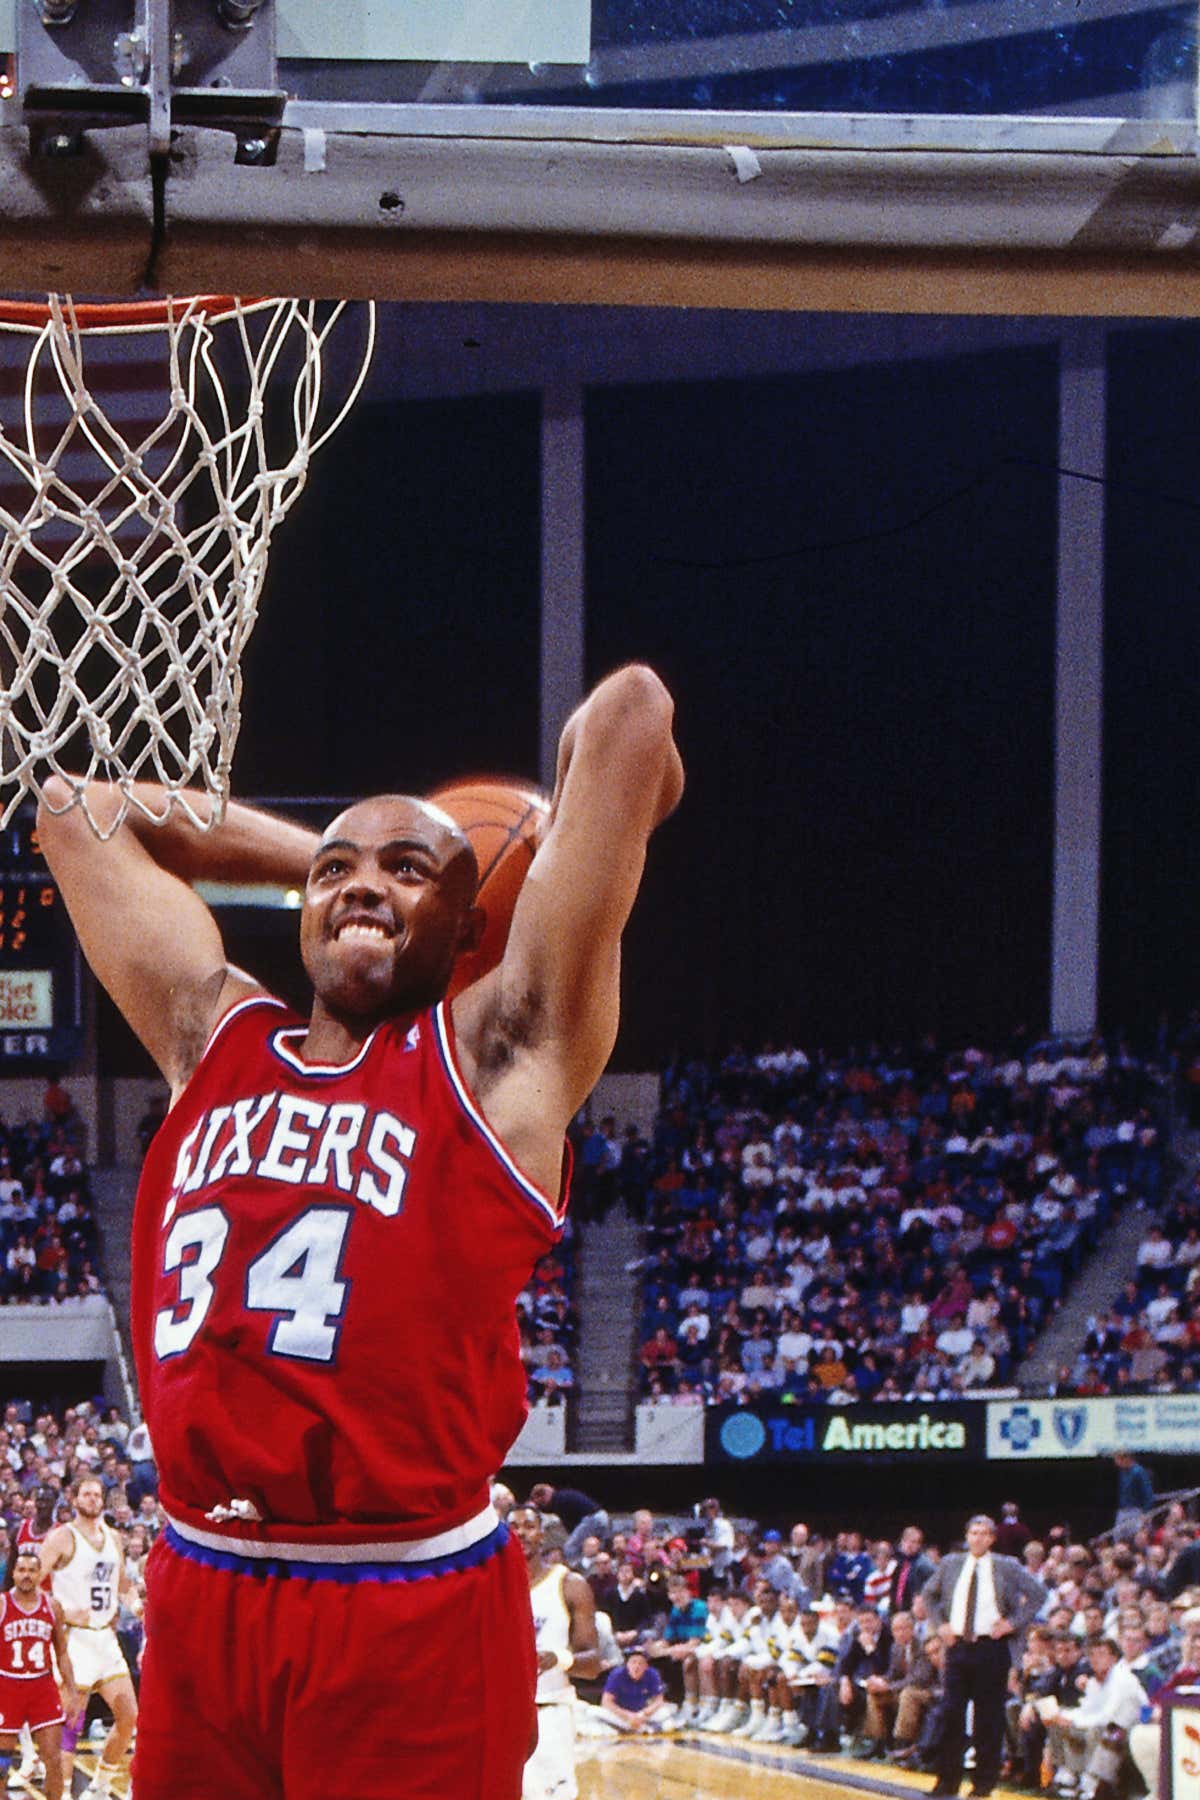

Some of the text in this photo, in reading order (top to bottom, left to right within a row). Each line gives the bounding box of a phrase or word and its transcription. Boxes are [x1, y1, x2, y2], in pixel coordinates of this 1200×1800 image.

[152, 1203, 355, 1364] 34
[823, 1413, 966, 1452] America
[3, 1618, 54, 1642] SIXERS
[10, 1640, 45, 1669] 14
